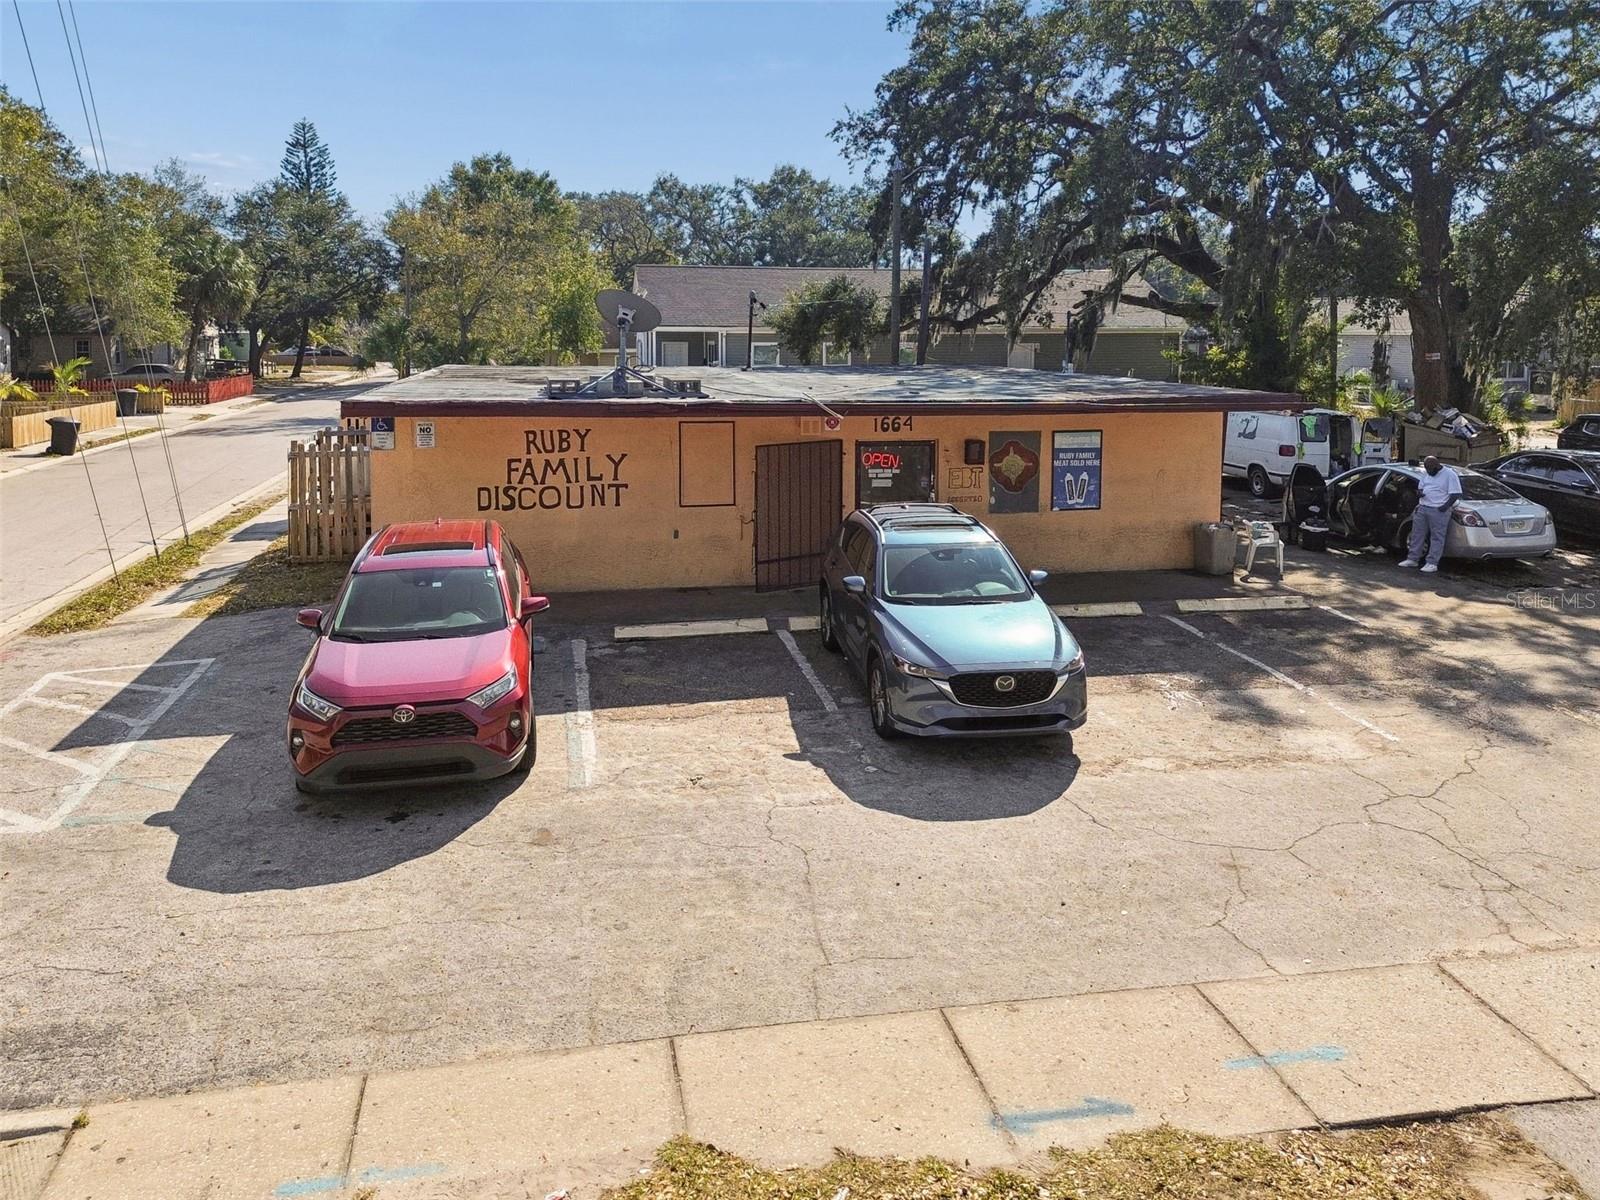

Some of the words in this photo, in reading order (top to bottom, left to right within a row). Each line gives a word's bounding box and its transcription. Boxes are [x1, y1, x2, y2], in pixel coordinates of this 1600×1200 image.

[873, 416, 913, 432] 1664
[524, 428, 592, 455] RUBY
[506, 453, 628, 485] FAMILY
[862, 452, 900, 469] OPEN
[948, 466, 983, 489] EBT
[477, 483, 629, 512] DISCOUNT
